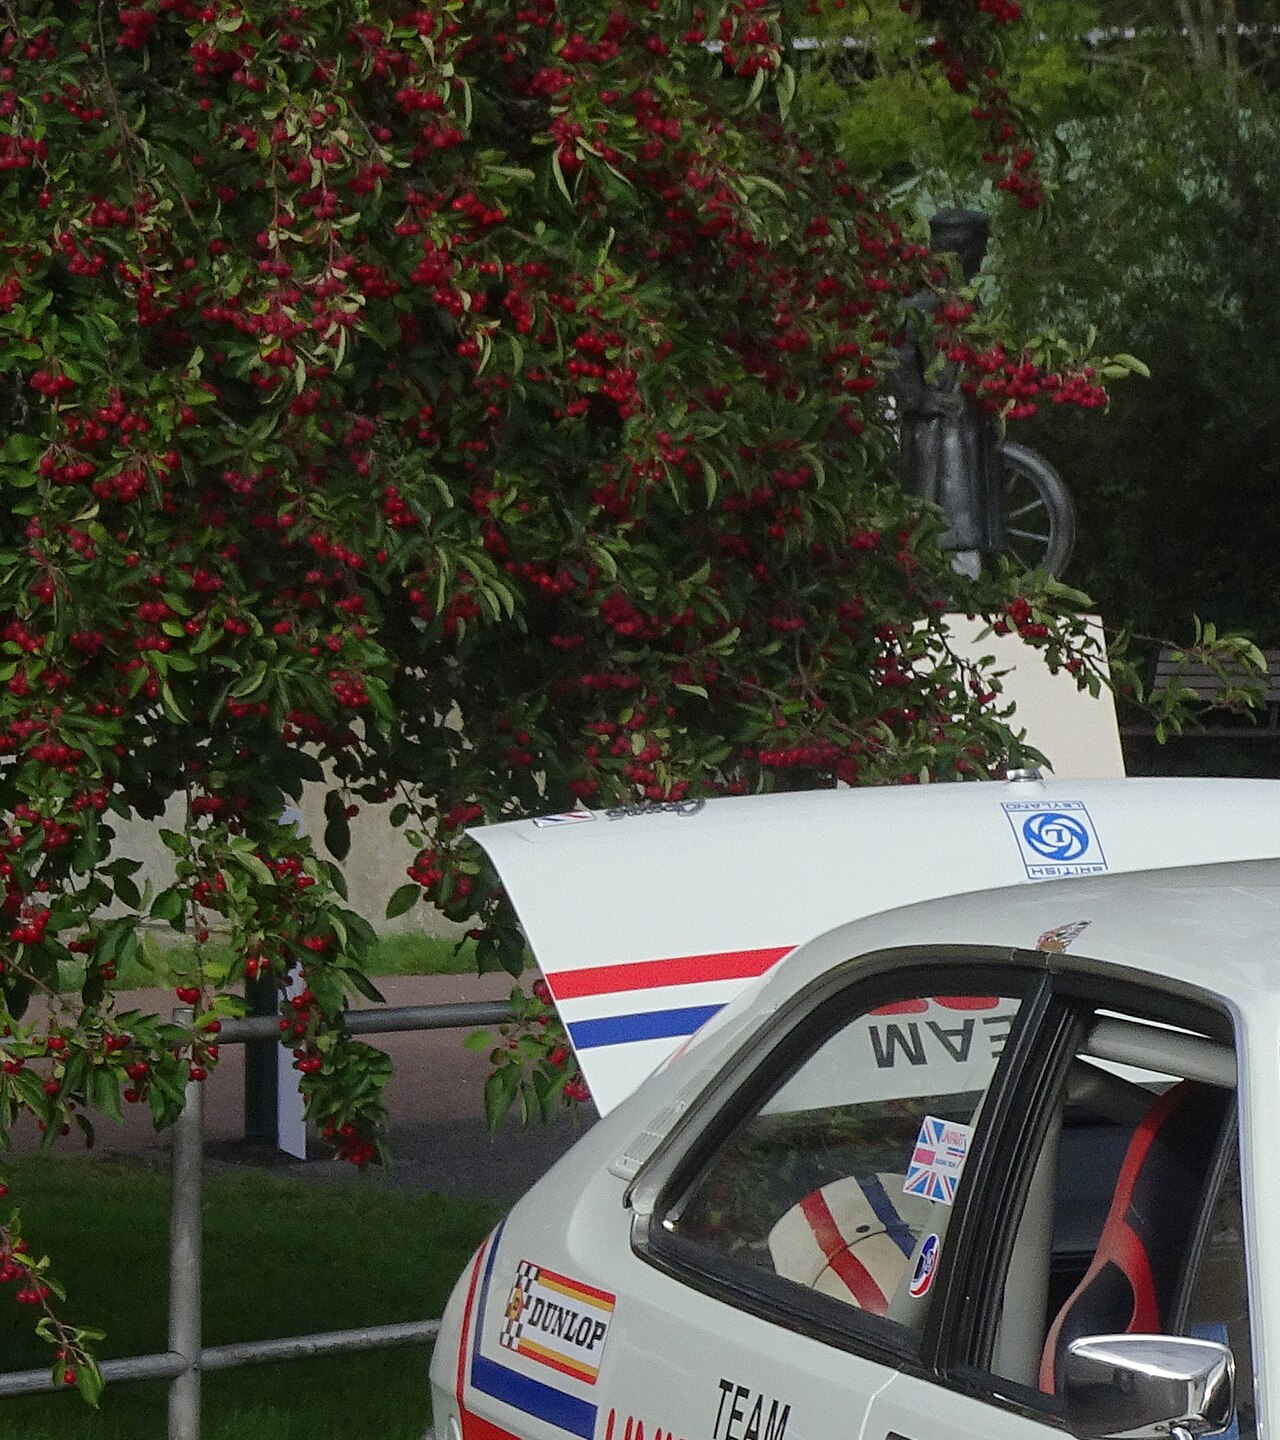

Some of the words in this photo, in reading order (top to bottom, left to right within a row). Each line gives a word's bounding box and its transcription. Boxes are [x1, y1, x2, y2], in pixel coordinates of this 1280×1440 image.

[1004, 801, 1082, 810] LEYLAND
[1031, 865, 1104, 877] BRITISH
[527, 1298, 608, 1351] DUNLOP
